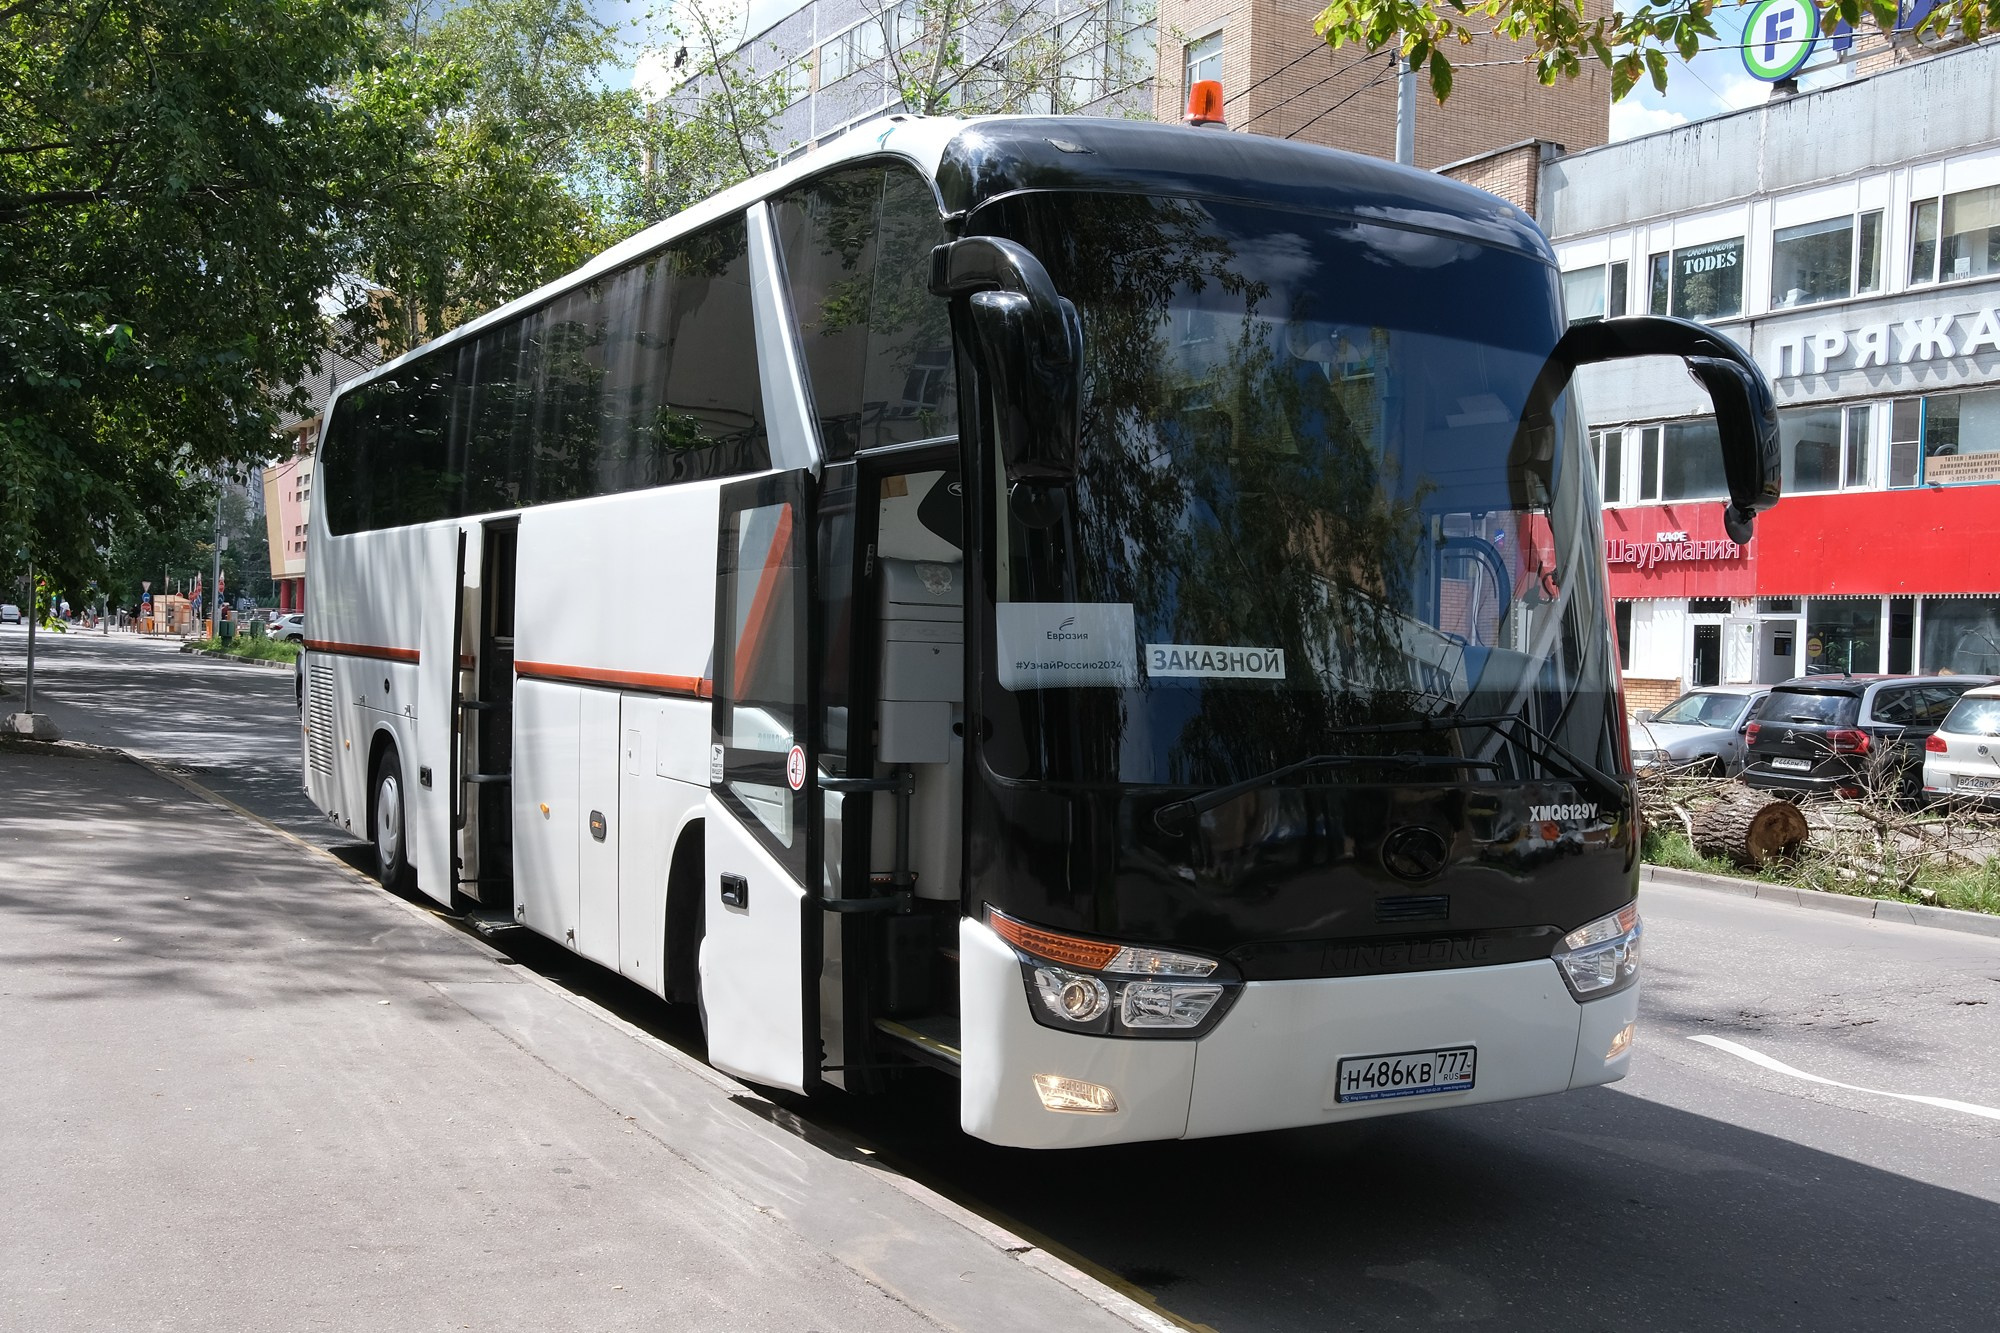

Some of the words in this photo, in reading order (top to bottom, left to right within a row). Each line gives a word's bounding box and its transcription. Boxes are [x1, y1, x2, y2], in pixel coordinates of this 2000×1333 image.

[1687, 248, 1707, 257] САЛОН
[1708, 242, 1735, 253] КРАСОТЫ
[1683, 251, 1737, 275] TODES
[1770, 308, 2000, 380] ПРЯЖА
[1656, 531, 1688, 542] КАФЕ
[1605, 539, 1740, 569] Шаурмания
[1047, 631, 1089, 642] Евразия
[1015, 660, 1123, 671] #УзнайРоссию2024
[1153, 648, 1280, 673] ЗАКАЗНОЙ
[1529, 803, 1598, 822] XMQ6129Y
[1347, 1059, 1432, 1090] Н486КВ
[1438, 1052, 1469, 1074] 777
[1443, 1072, 1459, 1081] RUS
